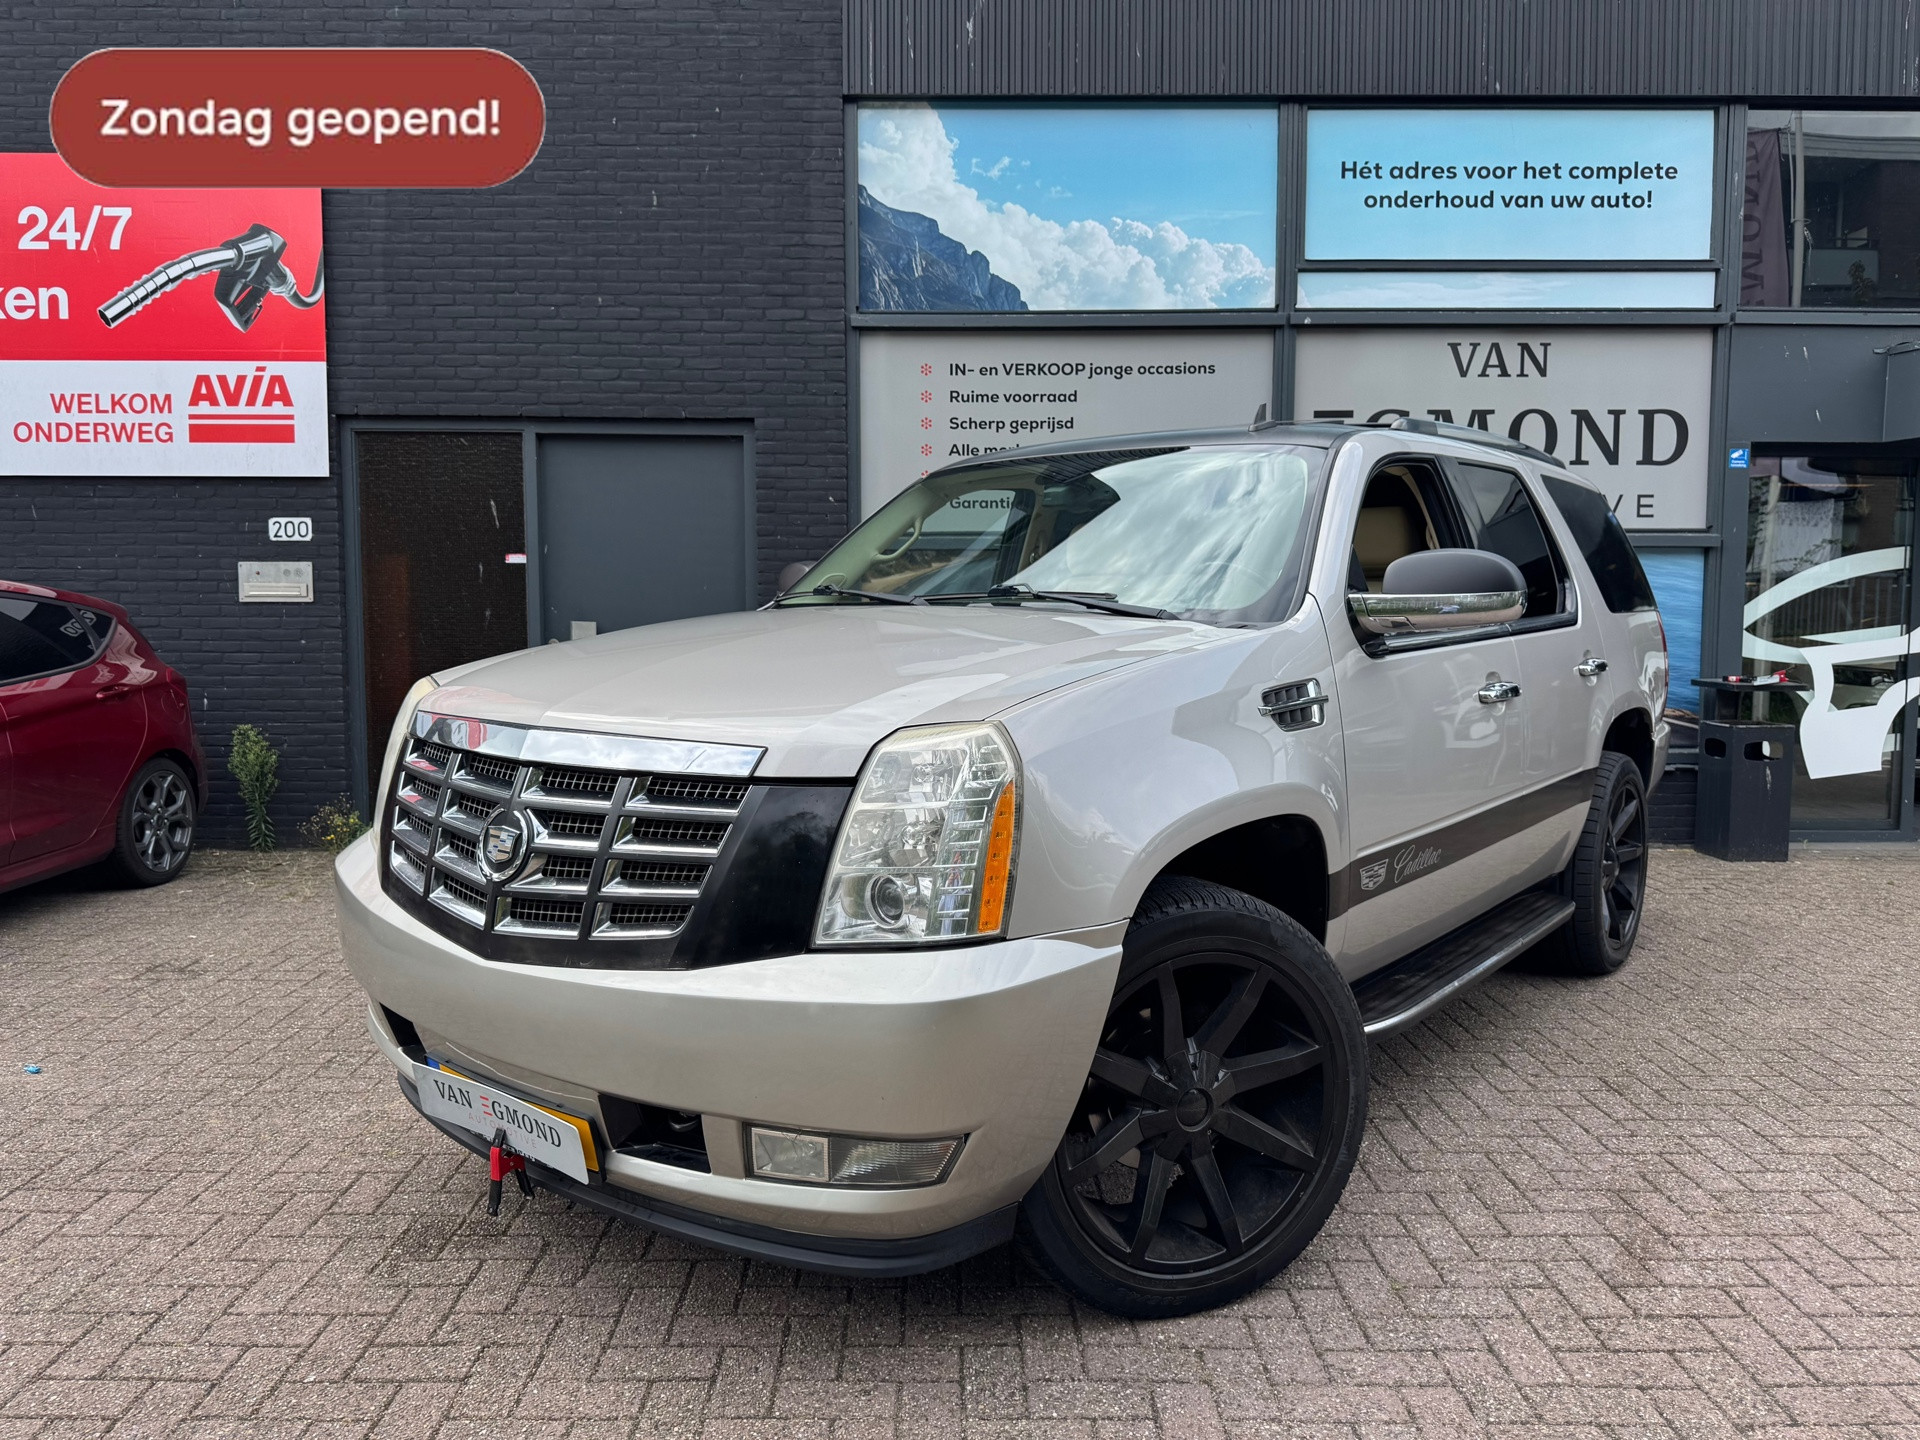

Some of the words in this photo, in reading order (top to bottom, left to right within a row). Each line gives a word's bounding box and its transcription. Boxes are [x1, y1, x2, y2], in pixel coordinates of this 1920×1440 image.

[1340, 161, 1383, 180] Hét
[1389, 161, 1458, 180] adres
[1463, 165, 1517, 180] voor
[1523, 161, 1562, 180] het
[1568, 161, 1679, 185] complete
[1363, 190, 1495, 209] onderhoud
[1501, 194, 1544, 209] van
[1550, 194, 1585, 209] uw
[1590, 190, 1653, 209] auto!
[17, 205, 133, 251] 24/7
[949, 363, 975, 376] IN-
[978, 365, 999, 376] en
[1001, 363, 1086, 376] VERKOOP
[1087, 362, 1134, 380] jonge
[1137, 361, 1216, 376] occasions
[1447, 341, 1552, 379] VAN
[188, 366, 294, 407] AVIA
[949, 390, 1000, 404] Ruime
[1003, 389, 1078, 404] voorraad
[49, 393, 173, 414] WELKOM
[13, 422, 174, 443] ONDERWEG
[949, 417, 1006, 430] Scherp
[1009, 417, 1074, 434] geprijsd
[948, 443, 980, 457] Alle
[949, 496, 1013, 509] Garanti
[272, 520, 309, 539] 200
[1393, 844, 1442, 884] Cadillac
[433, 1079, 473, 1109] VAN
[480, 1094, 562, 1148] EGMOND
